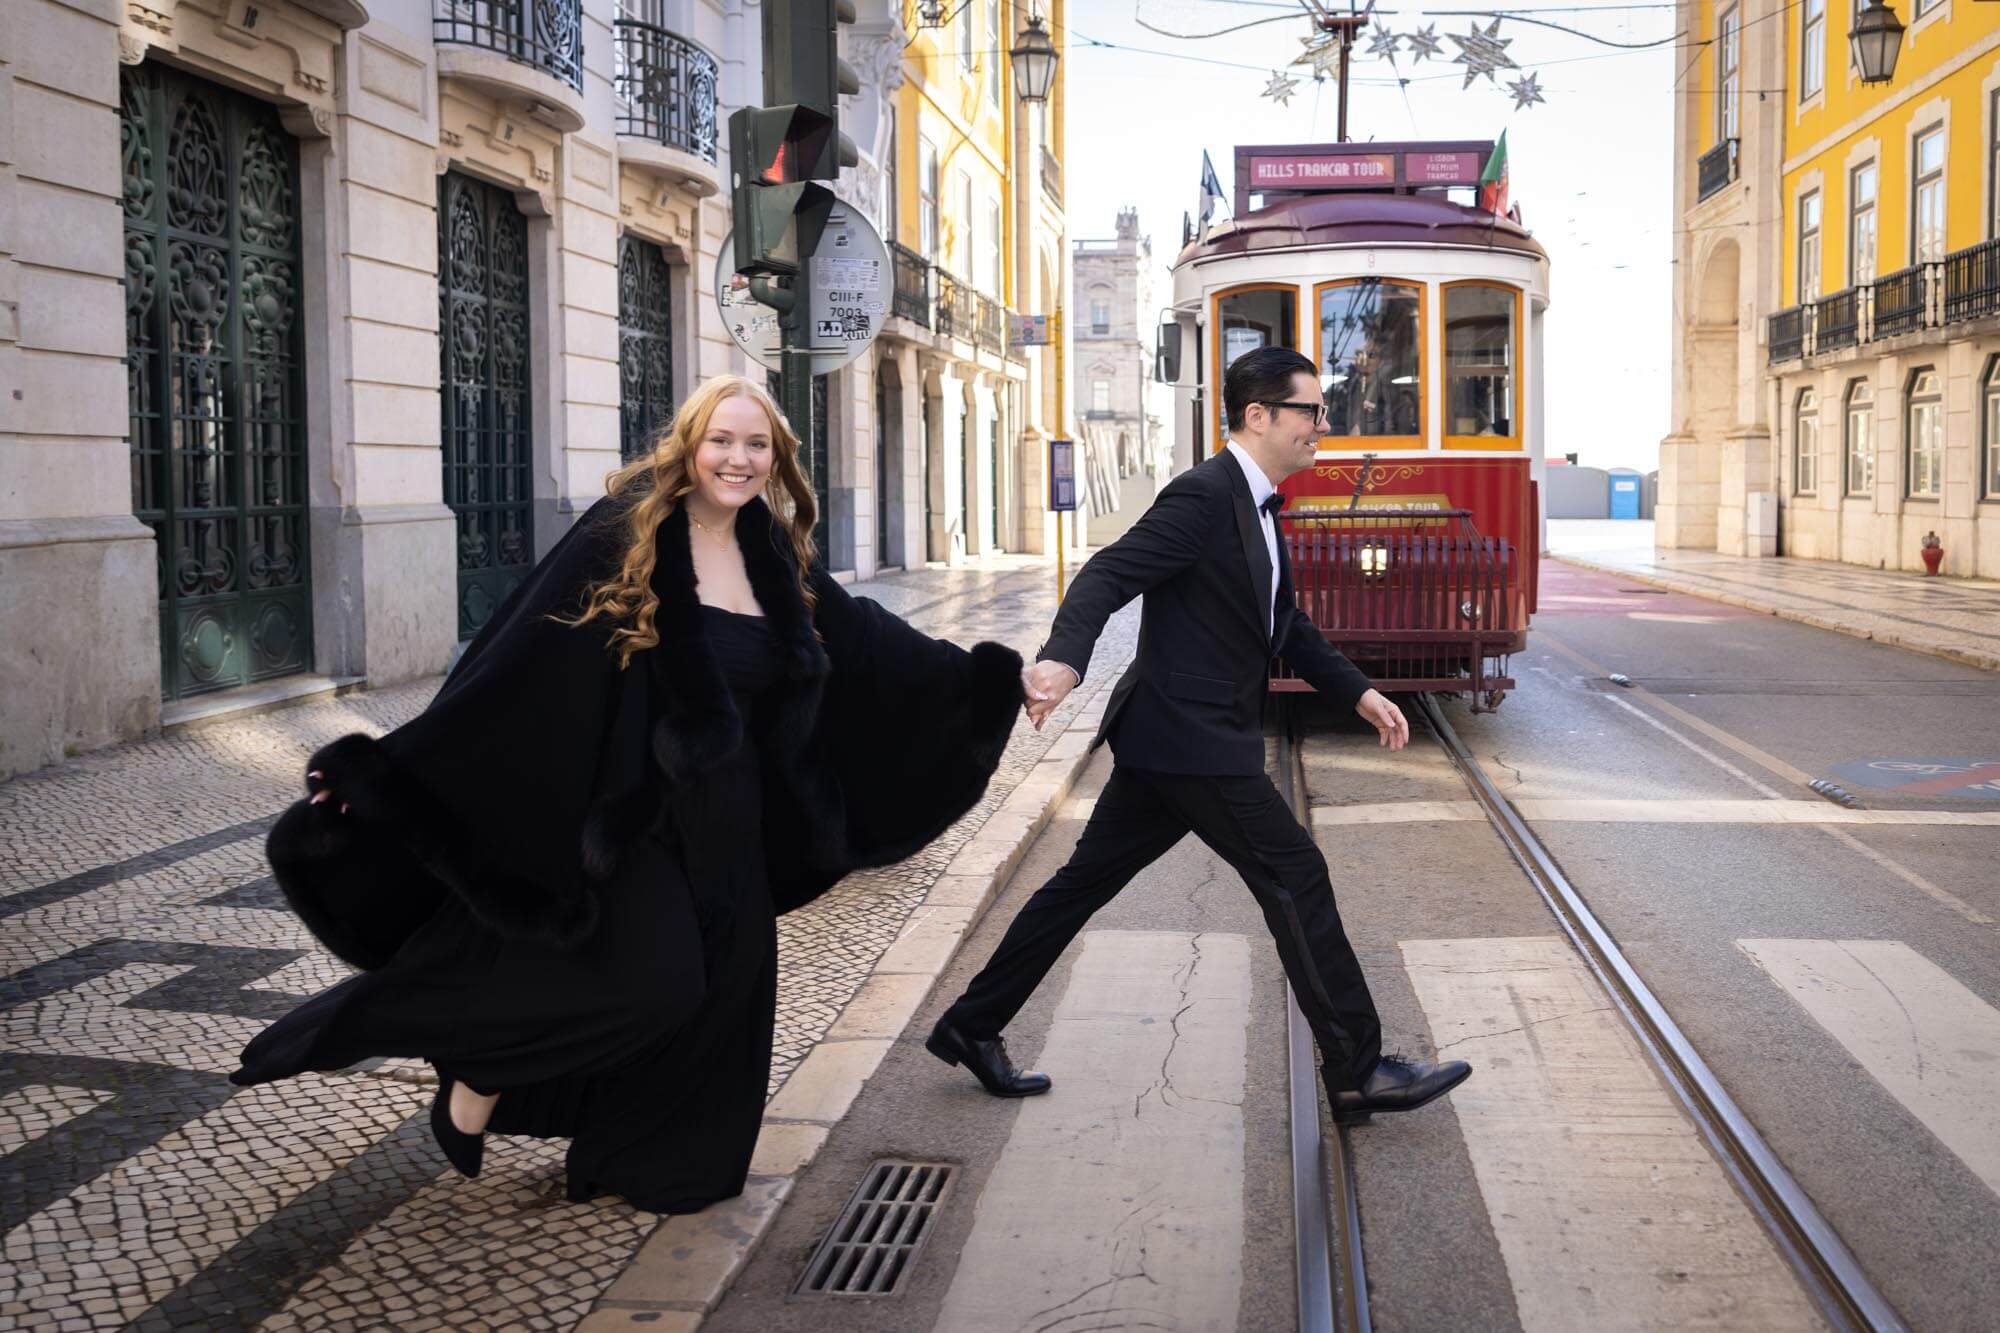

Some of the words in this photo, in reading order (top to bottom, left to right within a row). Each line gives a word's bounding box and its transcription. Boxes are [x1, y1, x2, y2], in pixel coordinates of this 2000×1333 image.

[1258, 164, 1294, 177] HILLS
[1297, 163, 1350, 177] TRAMCAR
[1353, 162, 1384, 176] TOUR
[1426, 163, 1459, 171] PREMIUM
[830, 307, 862, 317] 7003
